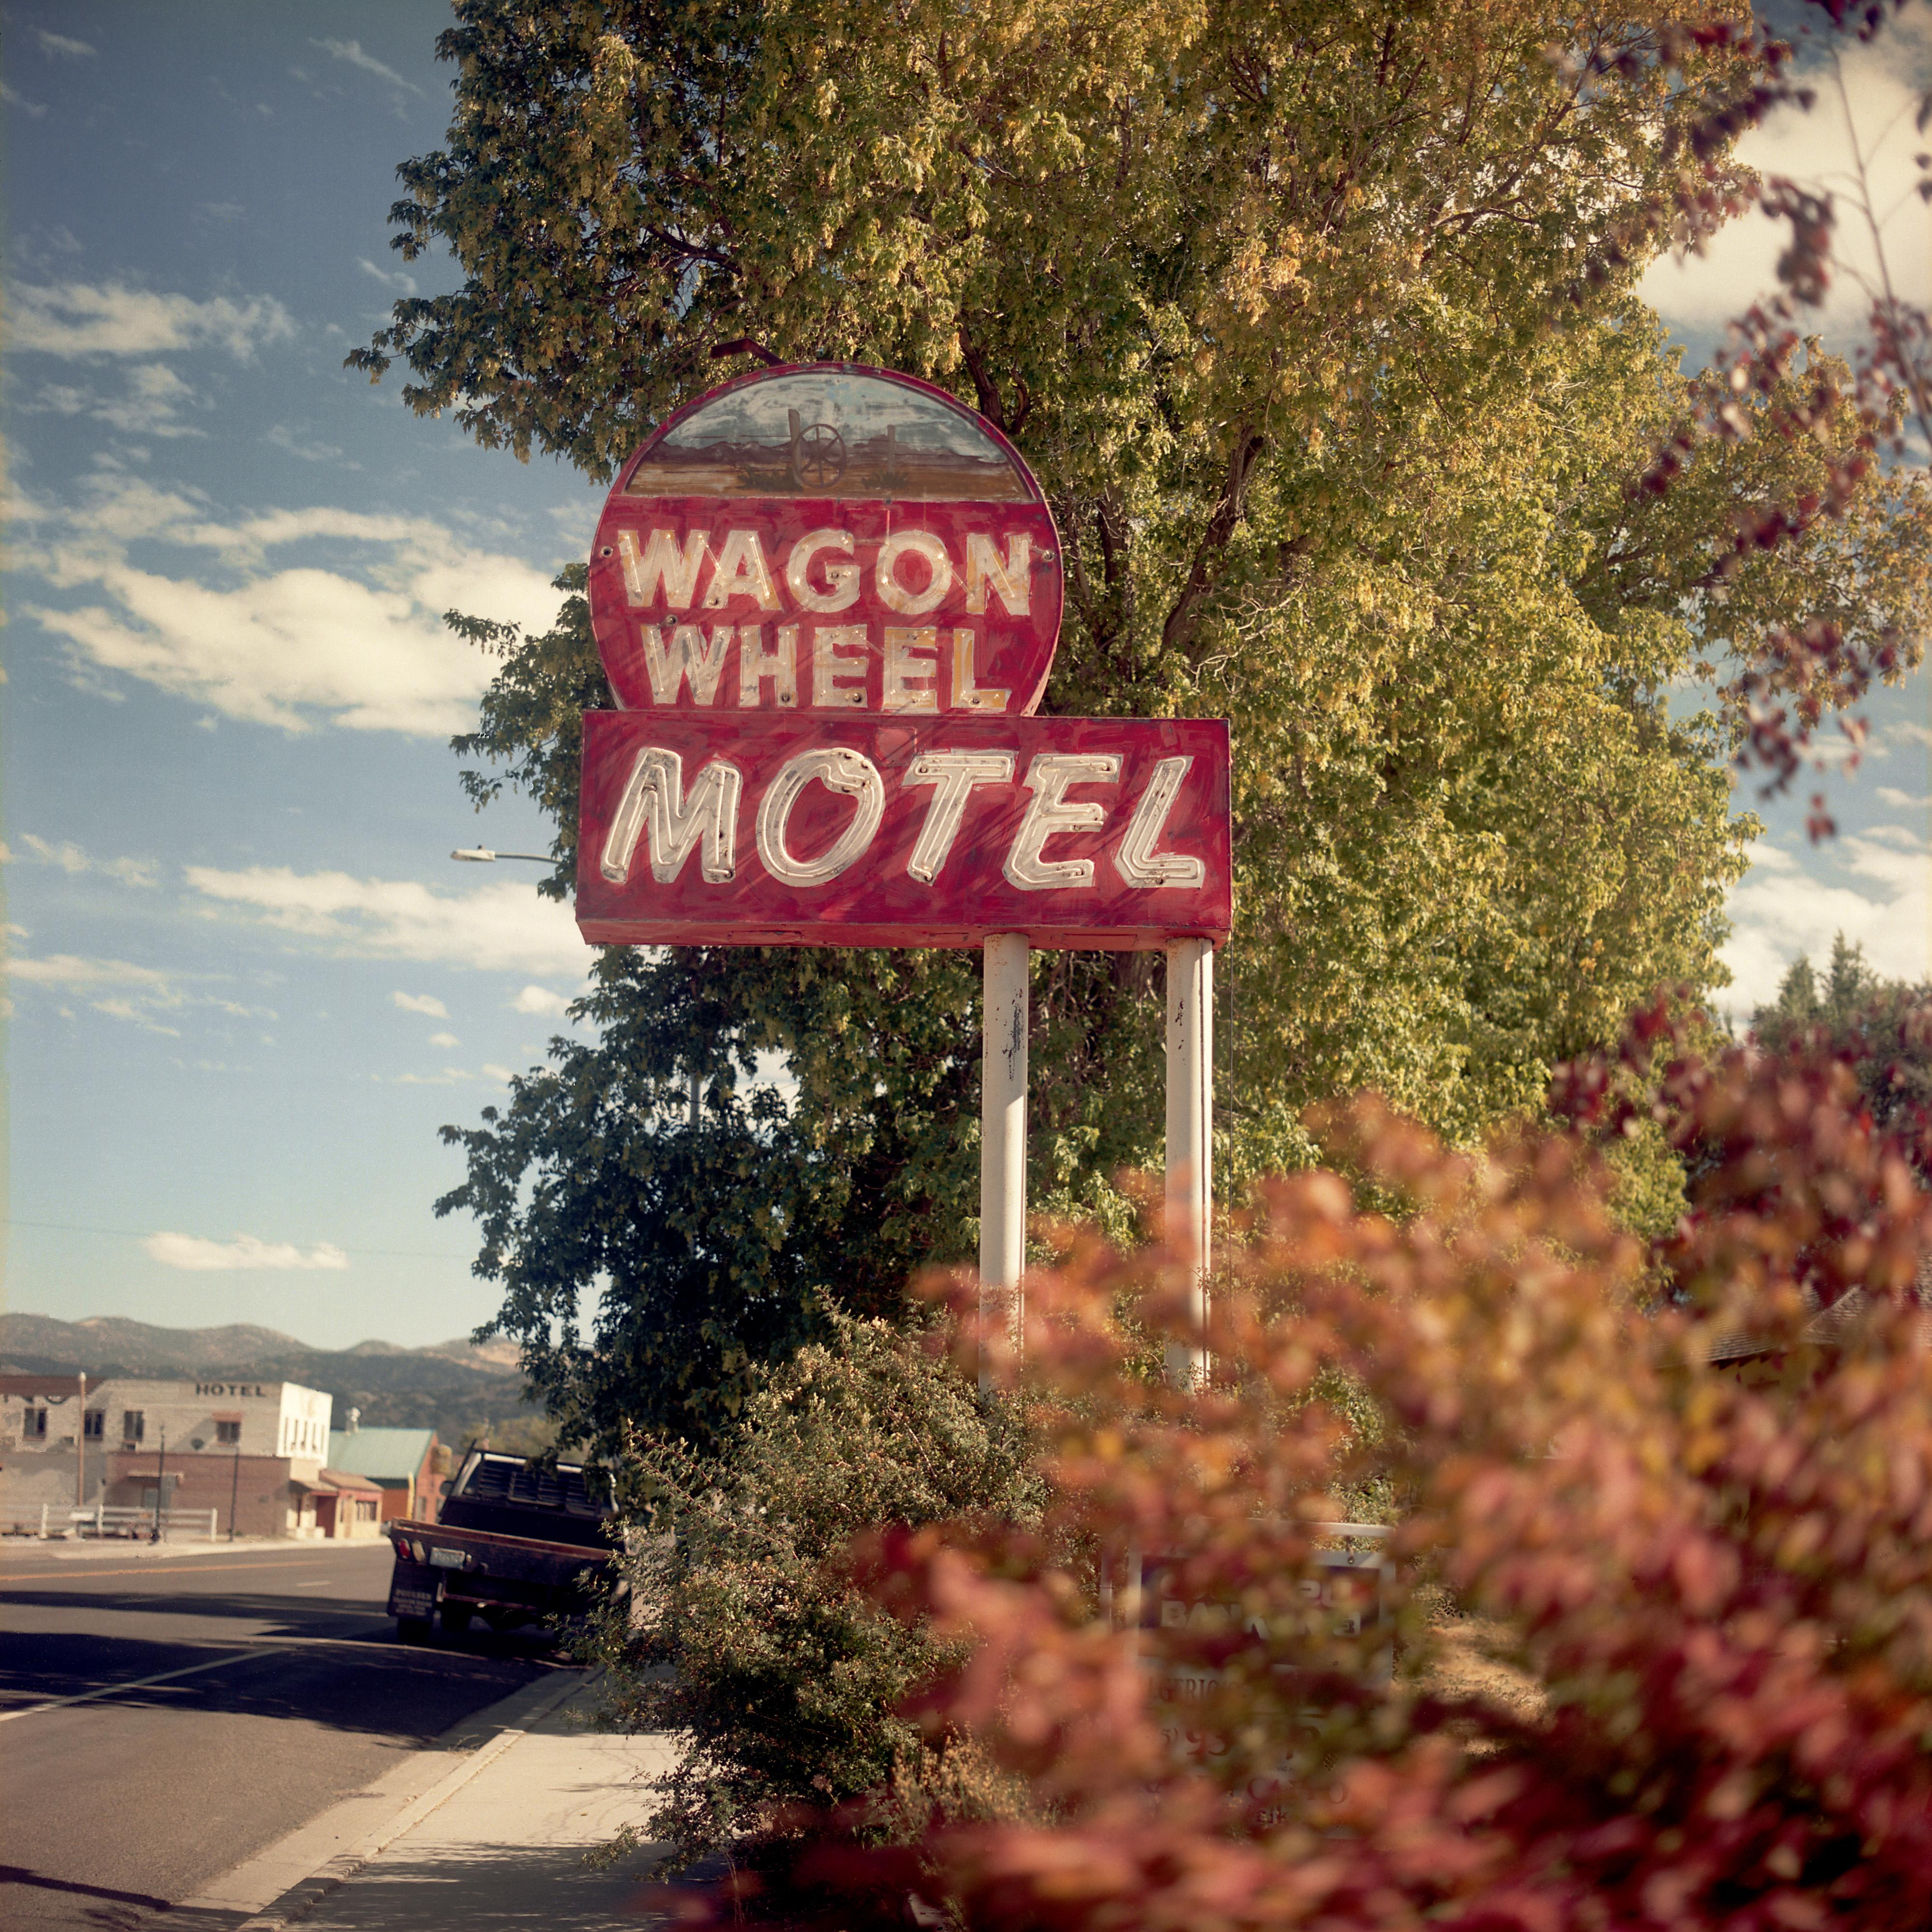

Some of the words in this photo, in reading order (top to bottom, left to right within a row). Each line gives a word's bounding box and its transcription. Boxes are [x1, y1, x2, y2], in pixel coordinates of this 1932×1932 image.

[617, 528, 1032, 616] WAGON
[639, 623, 1011, 713] WHEEL
[600, 747, 1207, 891] MOTEL
[196, 1383, 266, 1397] HOTEL
